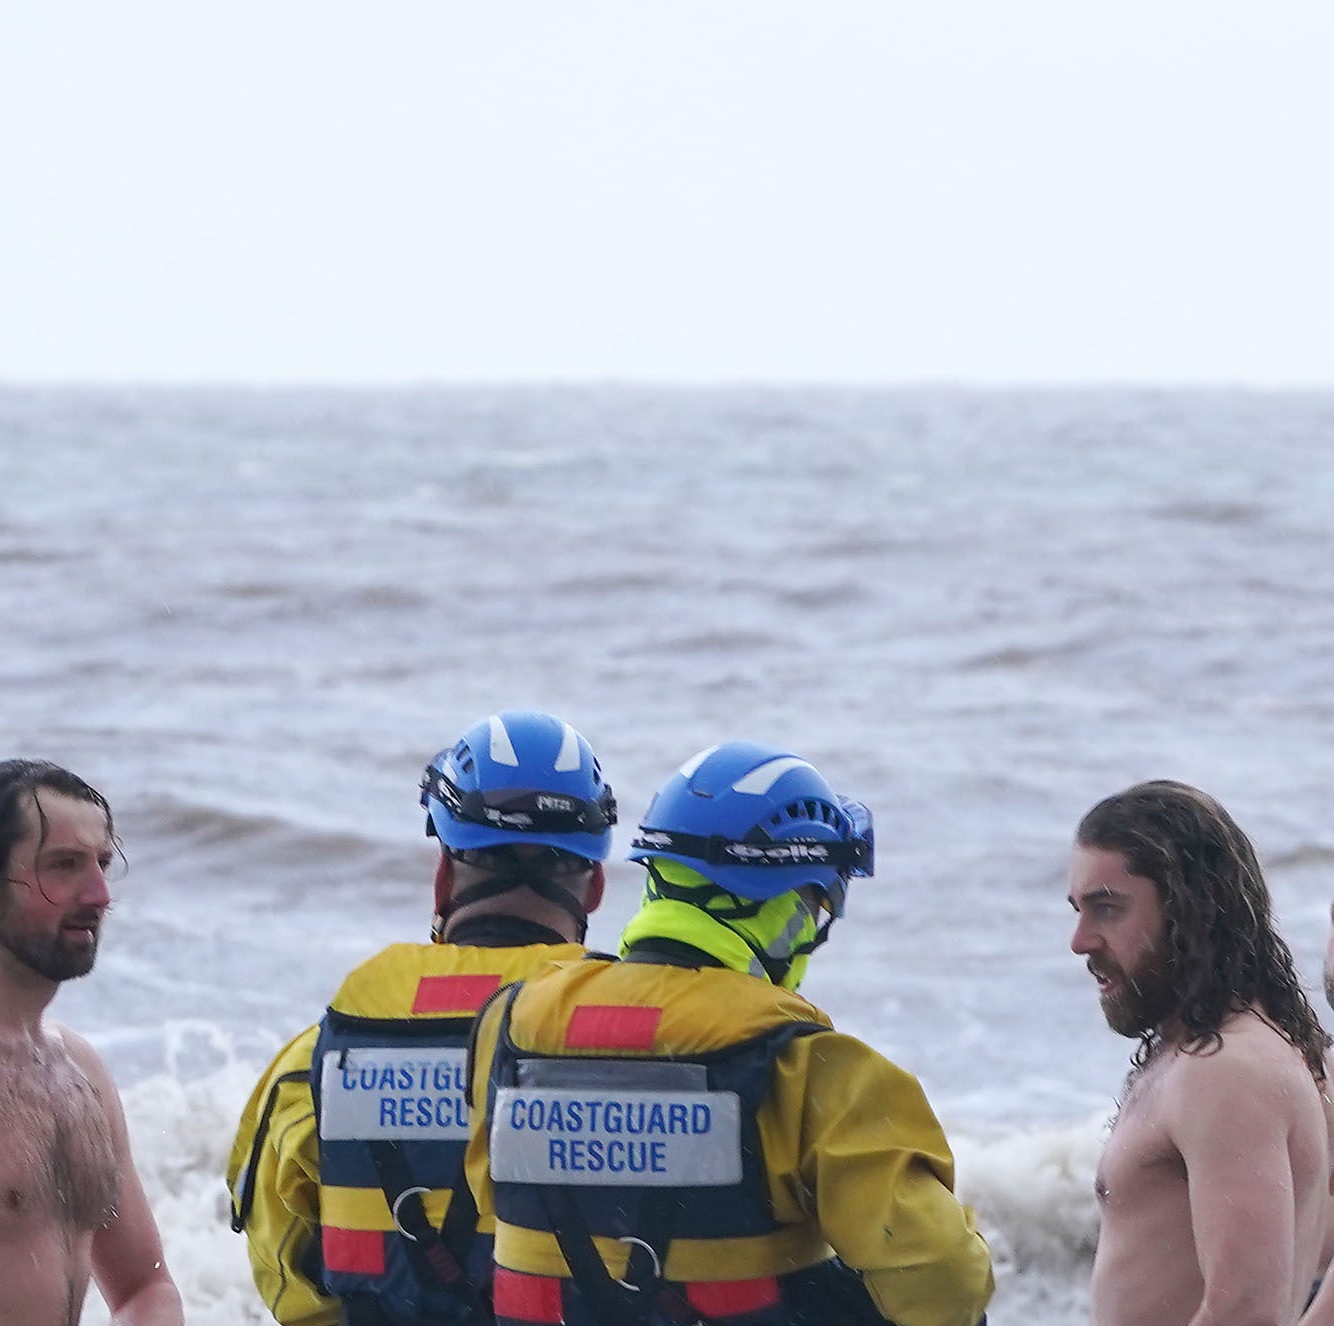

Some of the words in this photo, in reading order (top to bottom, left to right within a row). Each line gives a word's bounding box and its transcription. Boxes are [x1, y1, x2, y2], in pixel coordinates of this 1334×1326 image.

[342, 1061, 468, 1091] COASTGU
[379, 1097, 469, 1128] RESCU
[511, 1099, 711, 1135] COASTGUARD
[549, 1139, 666, 1173] RESCUE
